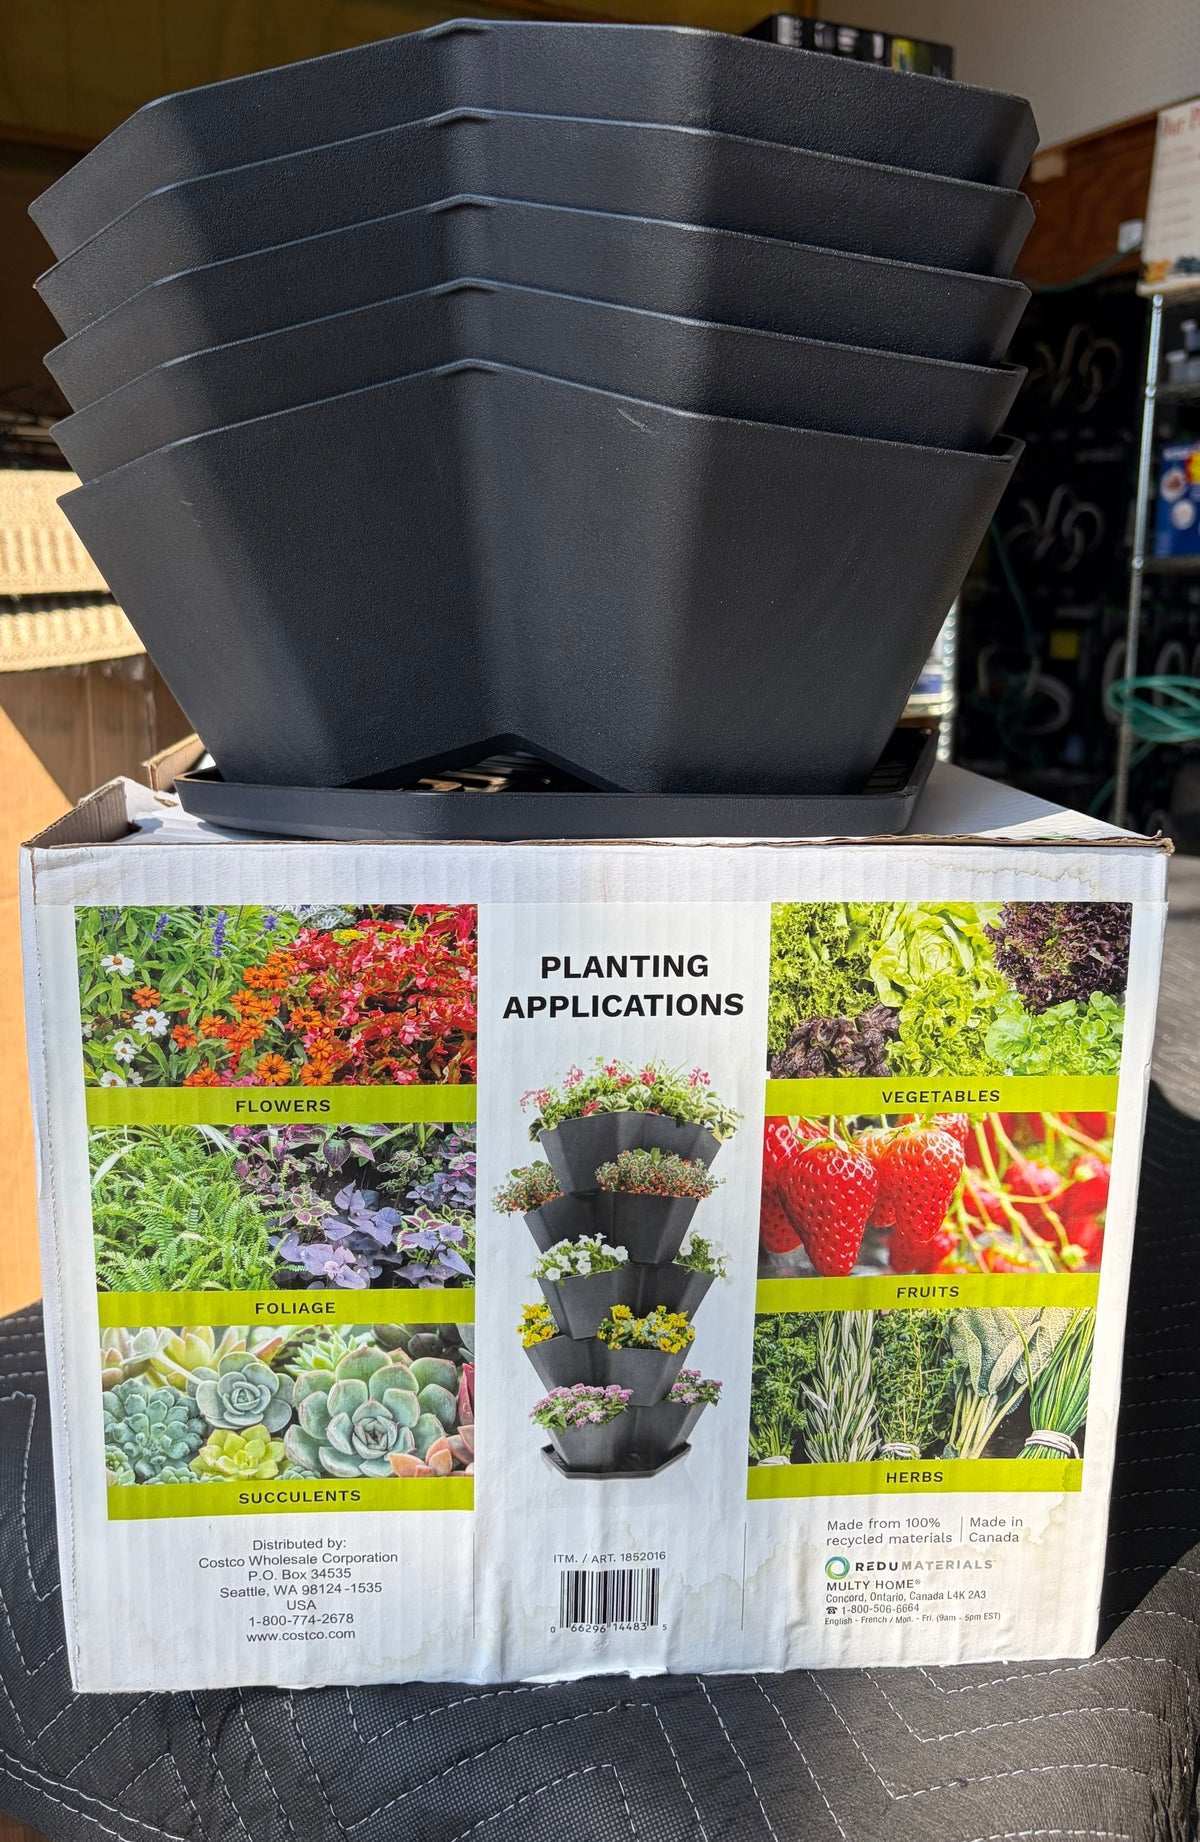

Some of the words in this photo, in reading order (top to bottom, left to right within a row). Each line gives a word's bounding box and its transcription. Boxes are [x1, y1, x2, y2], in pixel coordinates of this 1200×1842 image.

[541, 954, 709, 979] PLANTING
[502, 993, 745, 1019] APPLICATIONS
[881, 1089, 1001, 1104] VEGETABLES
[235, 1099, 331, 1113] FLOWERS
[896, 1285, 960, 1299] FRUITS
[254, 1301, 336, 1315] FOLIAGE
[886, 1471, 944, 1484] HERBS
[238, 1489, 361, 1505] SUCCULENTS
[827, 1519, 863, 1531] Made
[869, 1518, 901, 1529] from
[906, 1518, 940, 1528] 100%
[970, 1517, 1006, 1527] Made
[1011, 1517, 1023, 1527] in
[826, 1533, 883, 1547] recycled
[889, 1532, 953, 1544] materials
[969, 1532, 1019, 1543] Canada
[252, 1538, 323, 1551] Distributed
[327, 1538, 347, 1550] by:
[198, 1557, 245, 1569] Costco
[249, 1554, 318, 1566] Wholesale
[322, 1552, 398, 1566] Corporation
[553, 1554, 578, 1563] ITM.
[582, 1554, 588, 1563] /
[591, 1554, 616, 1563] ART.
[621, 1551, 666, 1562] 1852016
[248, 1570, 278, 1581] P.O.
[282, 1570, 307, 1580] Box
[311, 1568, 352, 1579] 34535
[220, 1586, 270, 1598] Seattle,
[273, 1585, 298, 1595] WA
[827, 1581, 870, 1591] MULTY
[826, 1592, 867, 1603] Concord,
[870, 1592, 906, 1602] Ontario,
[909, 1591, 944, 1601] Canada
[947, 1590, 965, 1600] L4K
[968, 1590, 986, 1600] 2A3
[286, 1600, 317, 1611] USA
[842, 1604, 919, 1615] 1-800-506-6664
[249, 1613, 354, 1627] 1-800-774-2678
[825, 1617, 852, 1626] English
[861, 1616, 887, 1624] French
[896, 1616, 914, 1624] Mon.
[922, 1614, 934, 1622] Fri.
[937, 1614, 956, 1623] (9am
[984, 1613, 1000, 1621] EST)
[571, 1624, 606, 1633] 66296
[613, 1622, 647, 1631] 14483
[246, 1629, 356, 1642] www.costco.com
